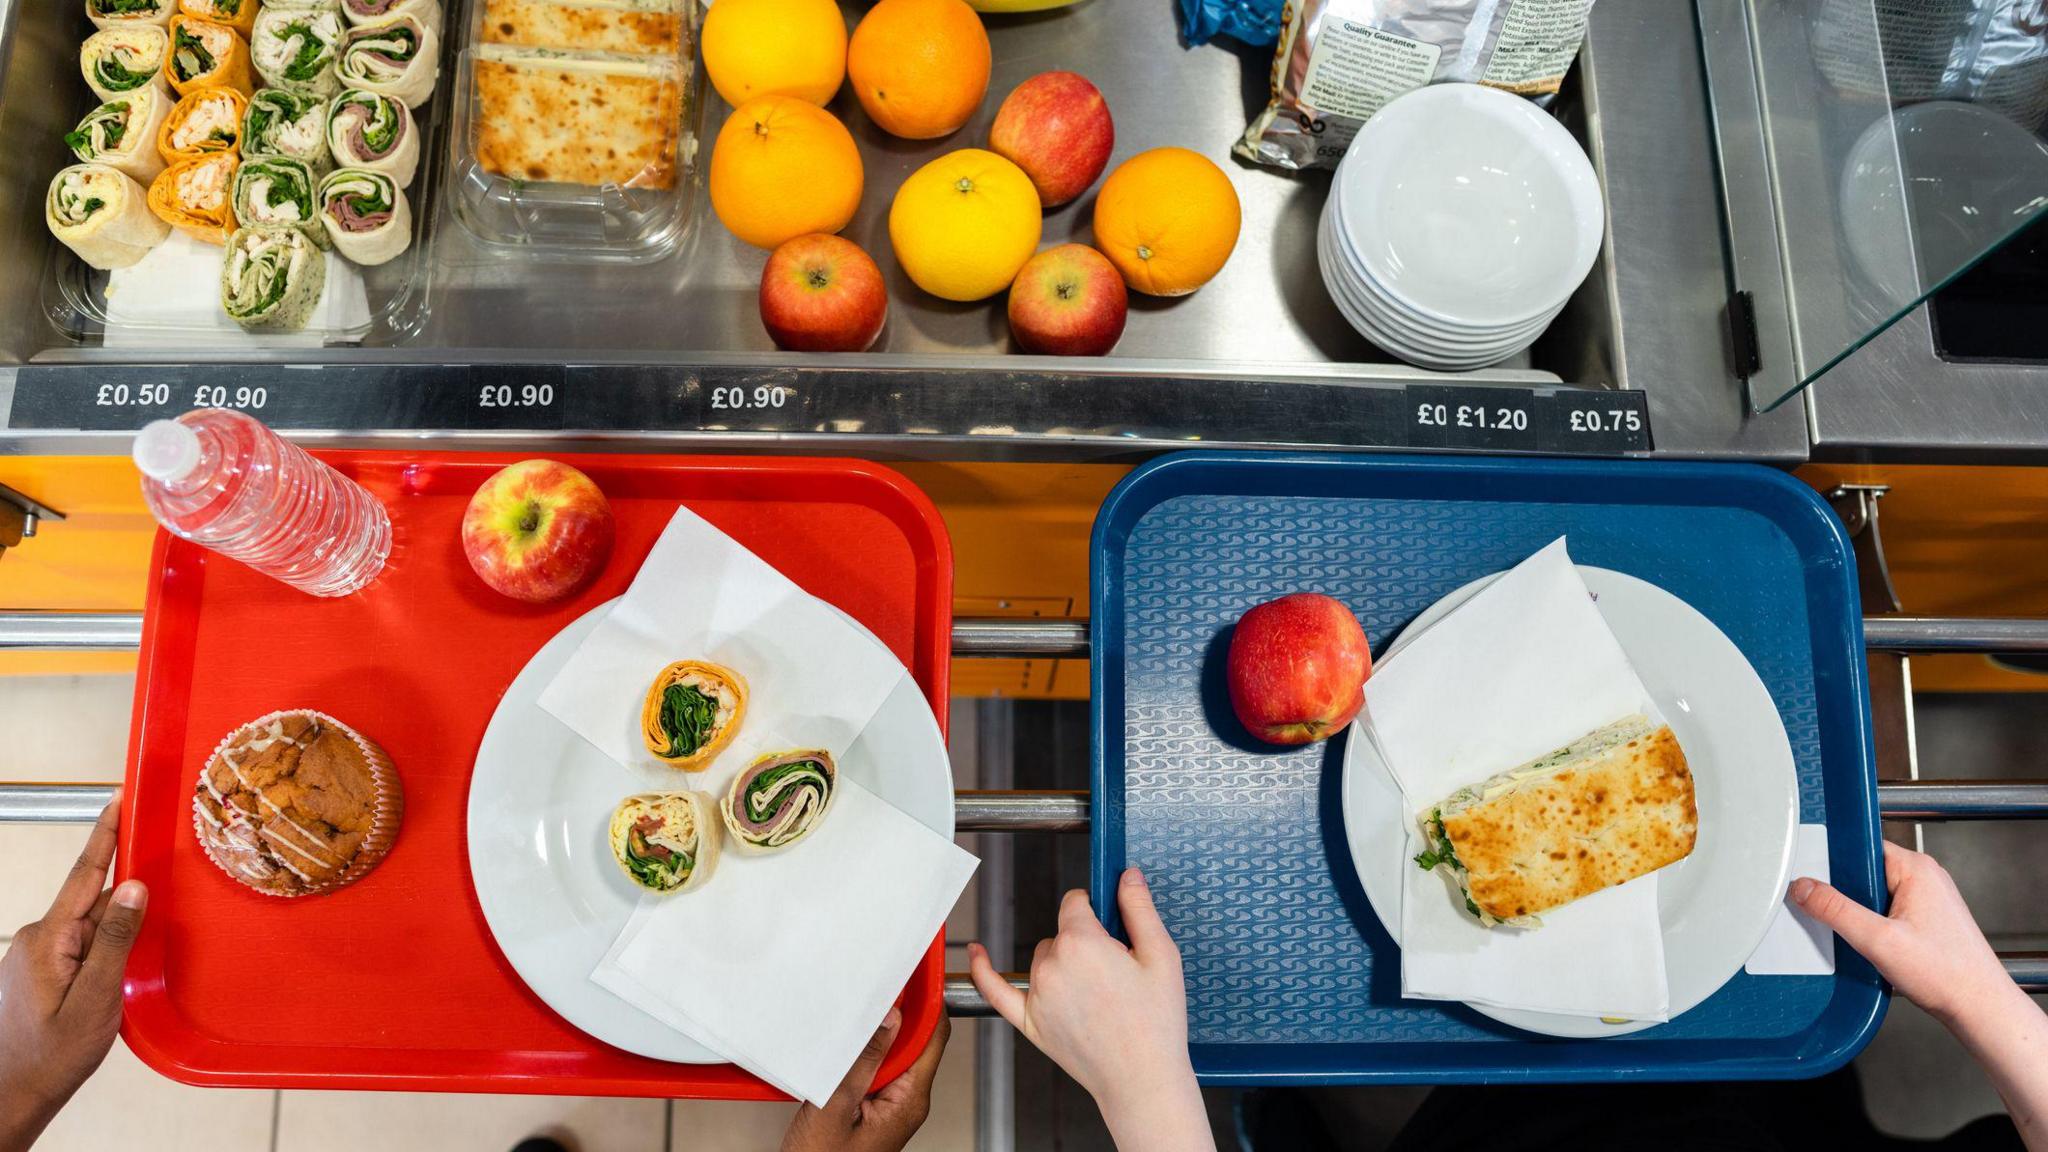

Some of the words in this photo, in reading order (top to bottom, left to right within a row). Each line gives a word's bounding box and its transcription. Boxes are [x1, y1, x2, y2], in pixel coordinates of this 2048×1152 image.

[1343, 22, 1372, 38] Quality
[1374, 32, 1417, 49] Guarantee
[96, 384, 170, 405] £0.50
[193, 385, 267, 409] £0.90
[479, 385, 553, 407] £0.90
[711, 386, 786, 409] £0.90
[1417, 403, 1447, 426] £0
[1456, 405, 1528, 431] £1.20
[1570, 410, 1641, 432] £0.75
